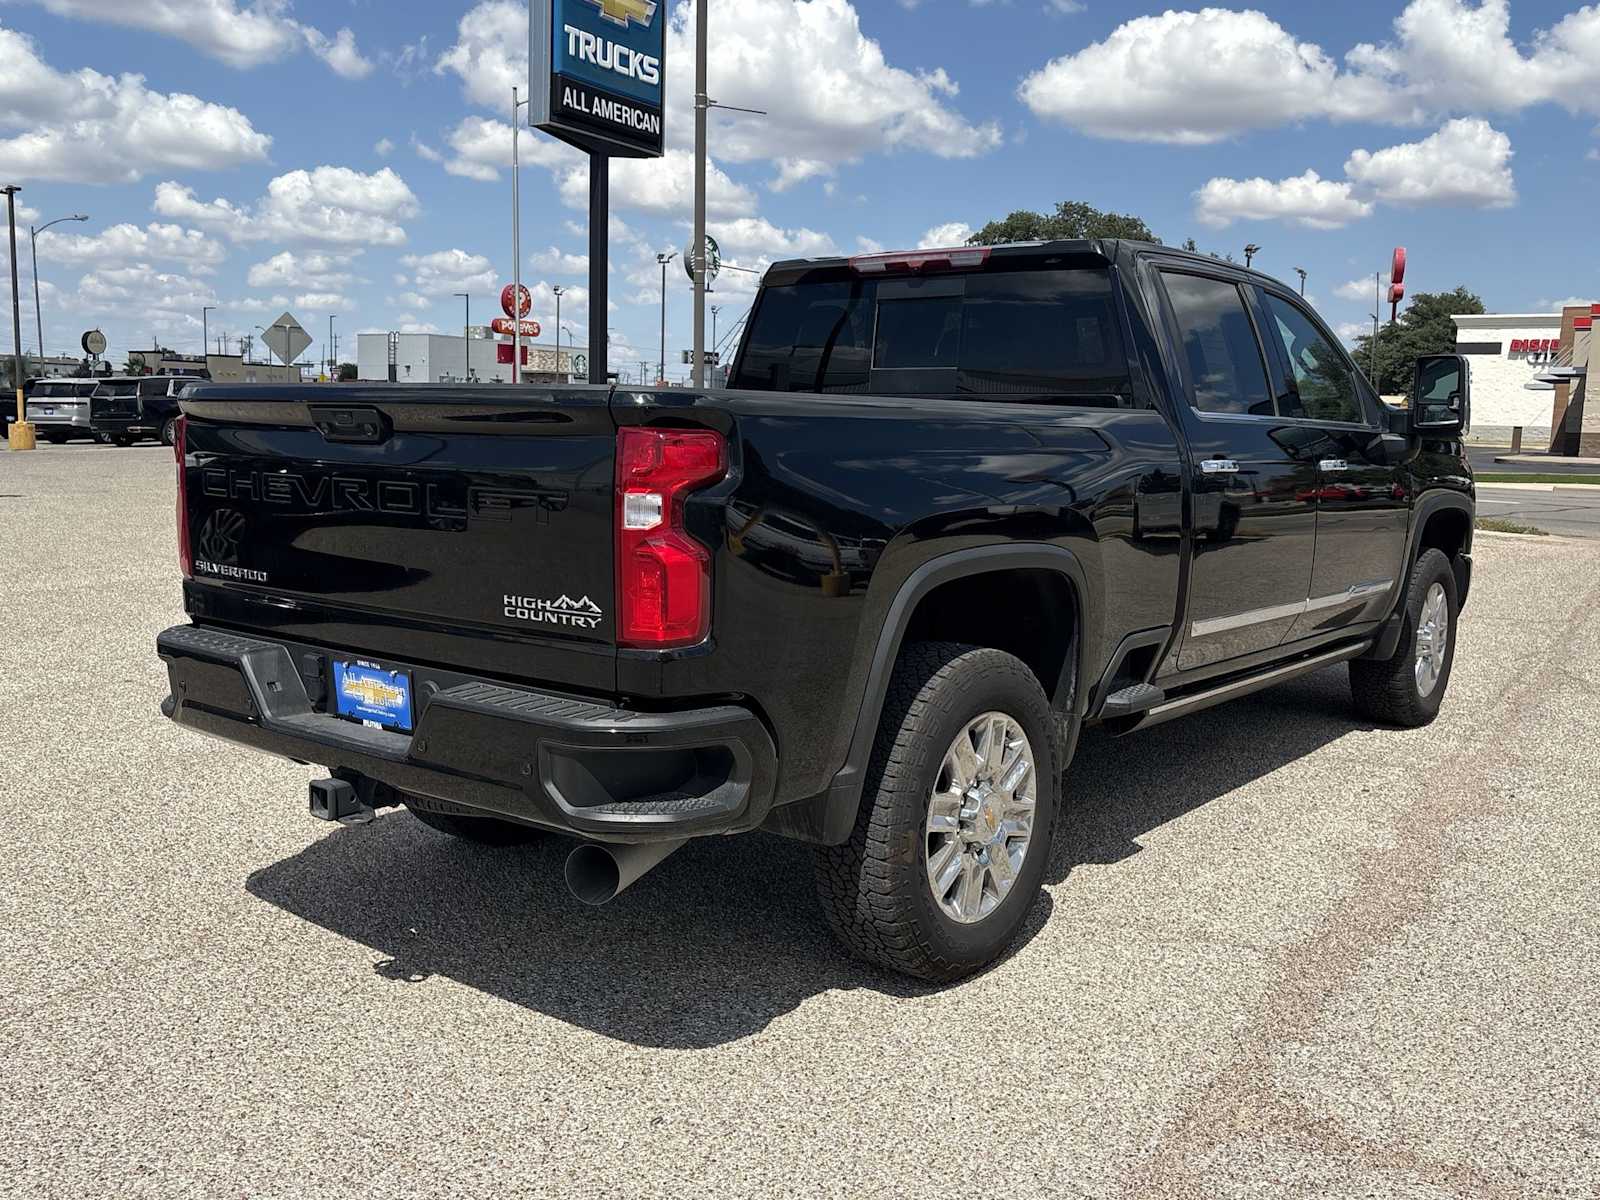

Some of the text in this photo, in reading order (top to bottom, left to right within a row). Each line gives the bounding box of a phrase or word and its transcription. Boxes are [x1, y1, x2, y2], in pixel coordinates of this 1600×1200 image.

[564, 24, 660, 85] TRUCKS
[563, 87, 660, 135] ALL AMERICAN
[201, 468, 567, 526] CHEVROLET
[195, 560, 267, 581] SILVERADO
[503, 594, 550, 610] HIGH
[504, 606, 602, 628] COUNTRY
